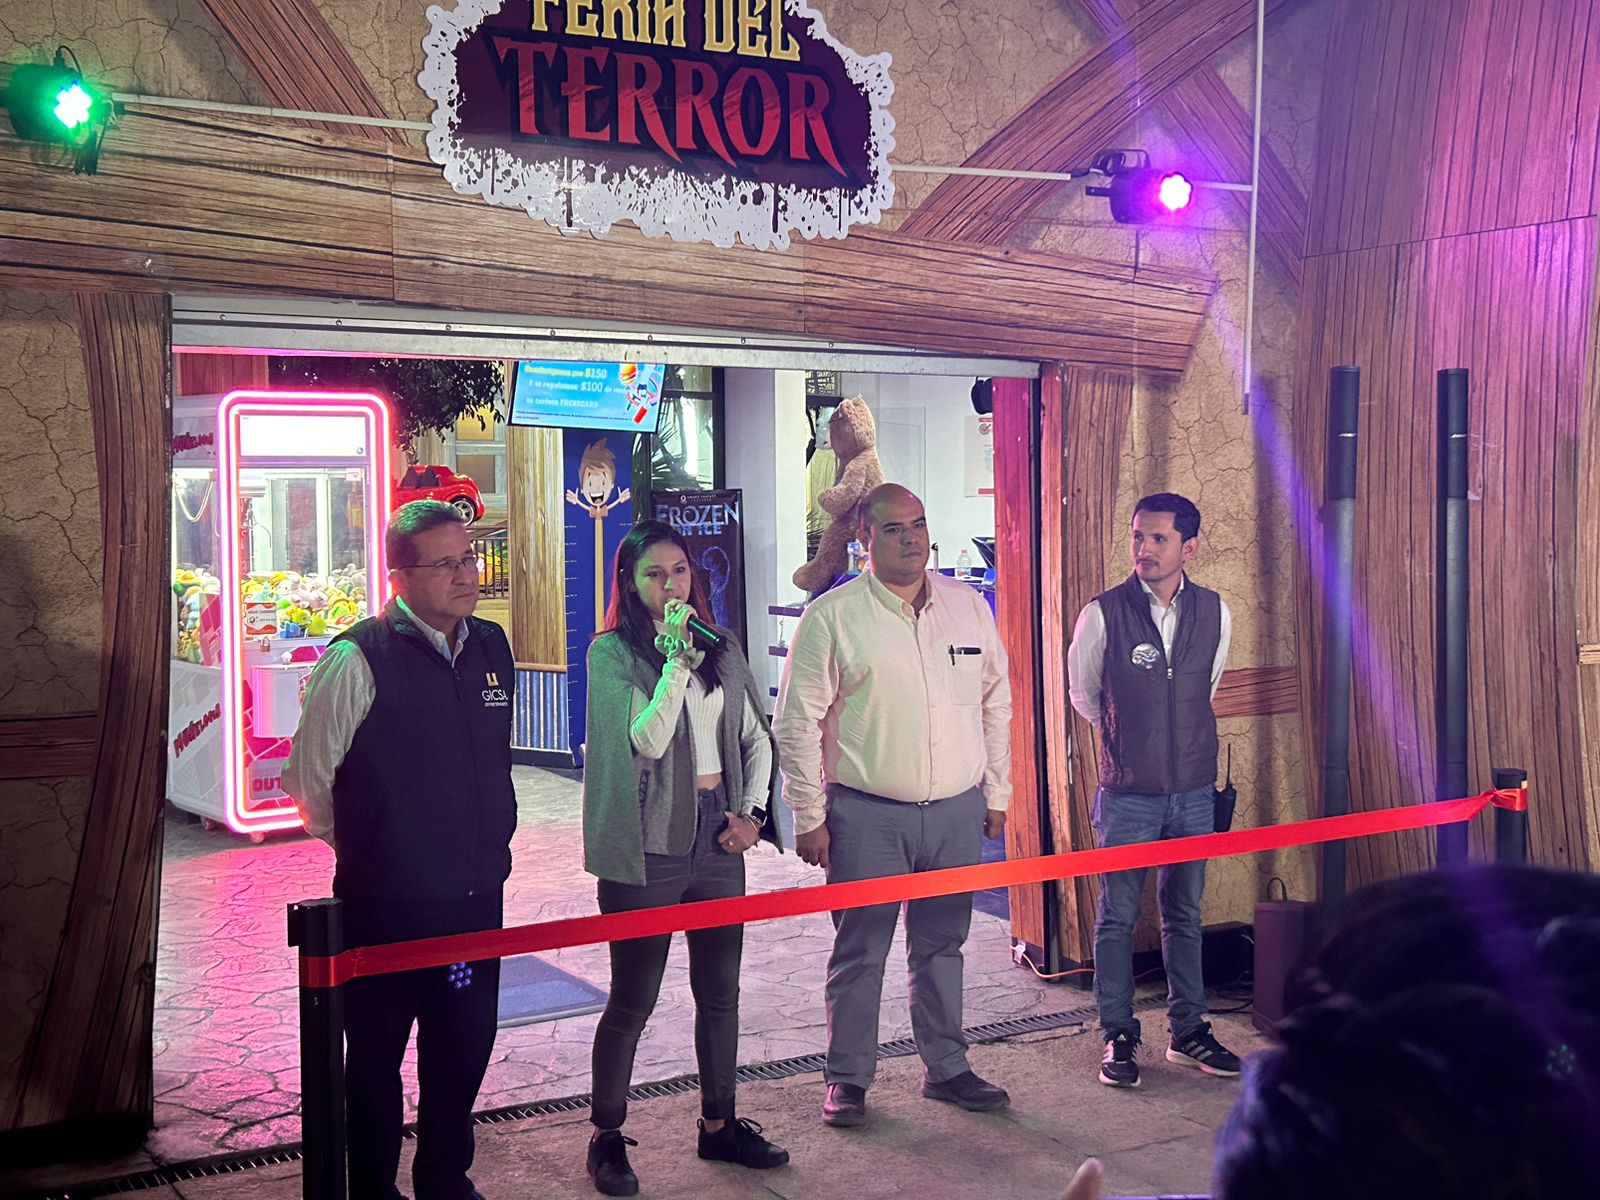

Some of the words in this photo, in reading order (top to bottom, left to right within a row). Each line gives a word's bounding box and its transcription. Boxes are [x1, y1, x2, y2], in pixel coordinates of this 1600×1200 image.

[703, 0, 801, 61] DEL
[492, 34, 848, 178] TERROR
[581, 381, 604, 392] $100
[655, 501, 740, 525] FROZEN
[698, 524, 722, 536] ICE
